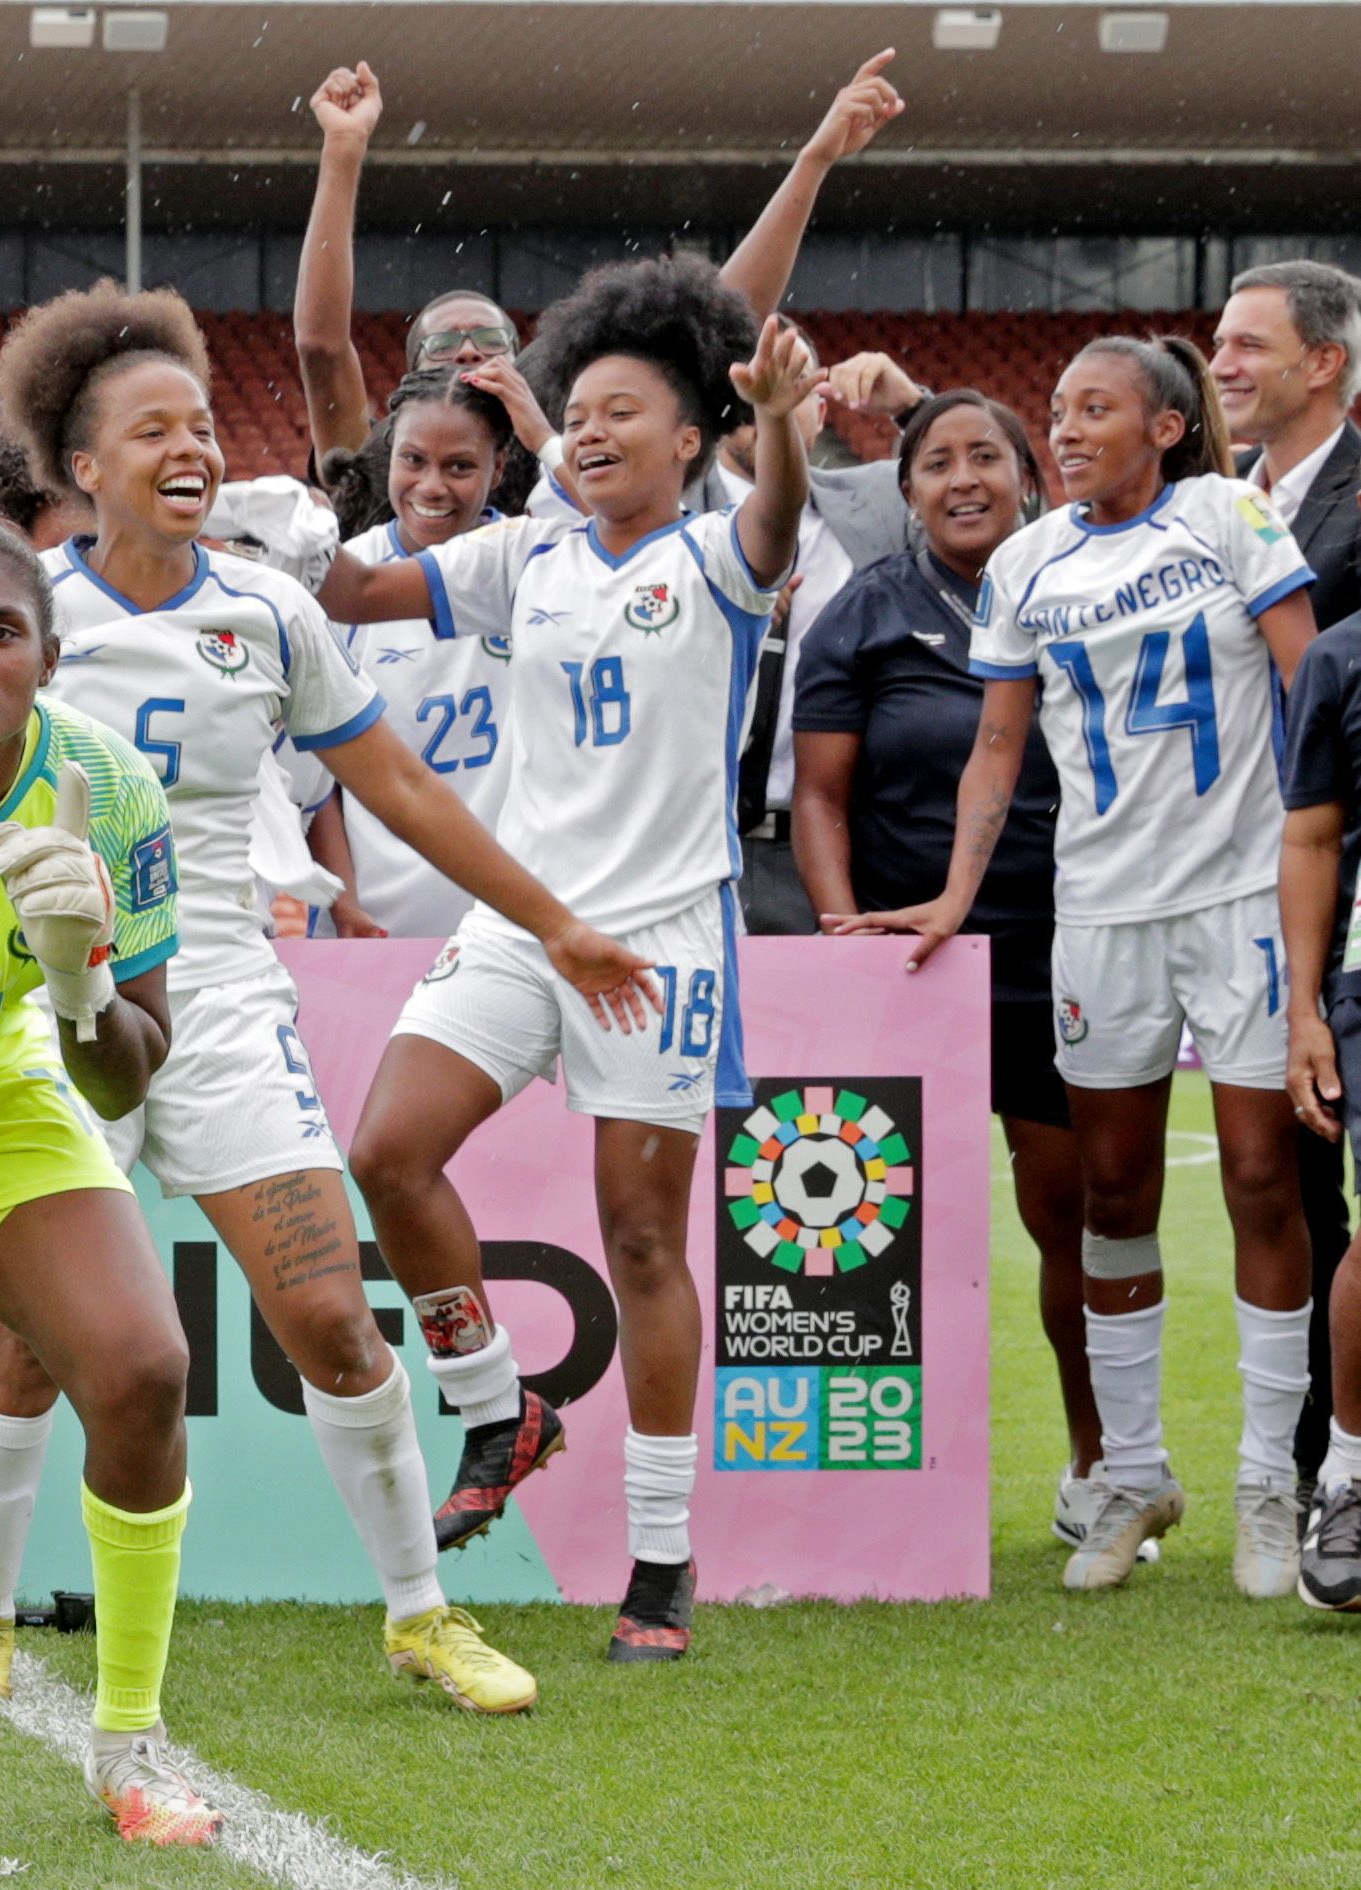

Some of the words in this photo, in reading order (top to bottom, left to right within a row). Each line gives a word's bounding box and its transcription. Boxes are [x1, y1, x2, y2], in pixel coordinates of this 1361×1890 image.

[560, 656, 630, 747] 18
[1047, 610, 1221, 816] 14
[135, 698, 185, 789] 5
[416, 684, 498, 774] 23
[654, 966, 715, 1057] 18
[276, 1024, 320, 1110] 5
[724, 1285, 793, 1309] FIFA
[725, 1311, 856, 1333] WOMEN'S
[725, 1336, 823, 1357] WORLD
[827, 1335, 882, 1357] CUP
[724, 1377, 808, 1418] AU
[829, 1376, 913, 1418] 20
[724, 1421, 807, 1461] NZ
[829, 1420, 912, 1461] 23
